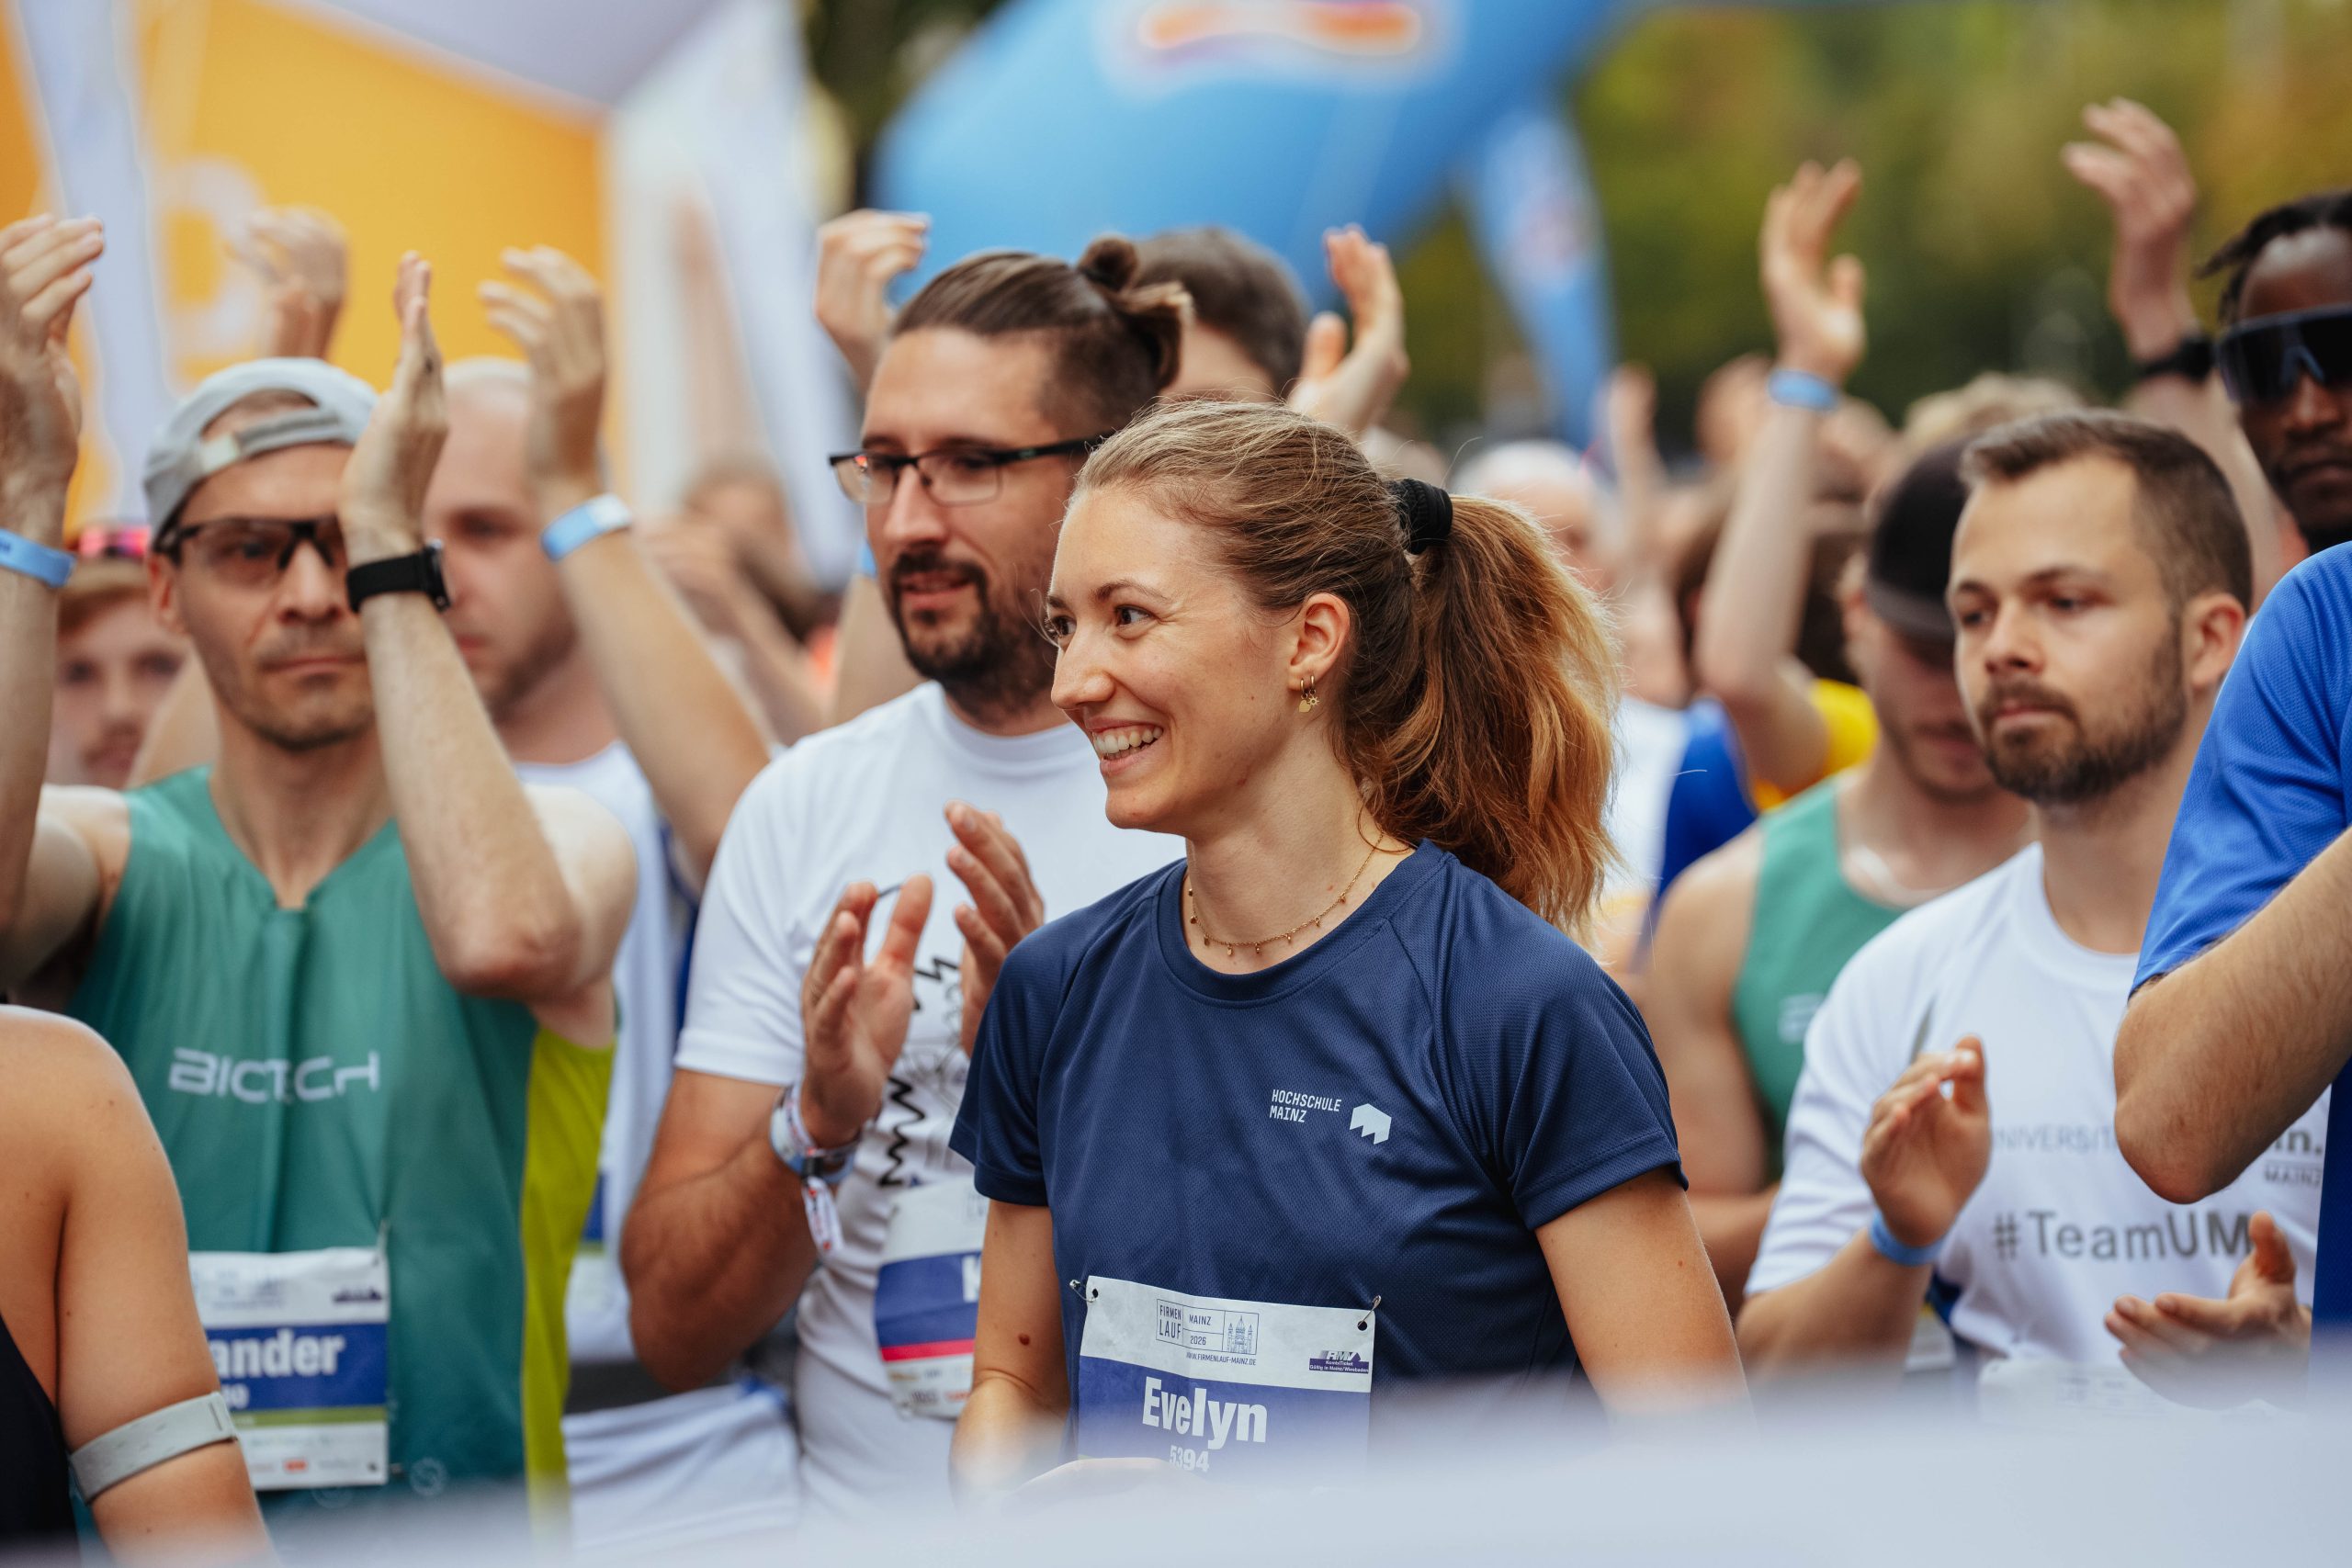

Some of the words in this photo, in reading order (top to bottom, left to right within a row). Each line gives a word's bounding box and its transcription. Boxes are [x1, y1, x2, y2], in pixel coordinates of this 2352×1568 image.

[1272, 1089, 1342, 1112] HOCHSCHULE
[1269, 1105, 1306, 1123] MAINZ
[1159, 1304, 1182, 1321] FIRMEN
[1189, 1314, 1212, 1326] MAINZ
[1159, 1319, 1182, 1339] LAUF
[1190, 1335, 1207, 1346] 2026
[1142, 1376, 1268, 1450] Evelyn
[1169, 1444, 1210, 1473] 5394
